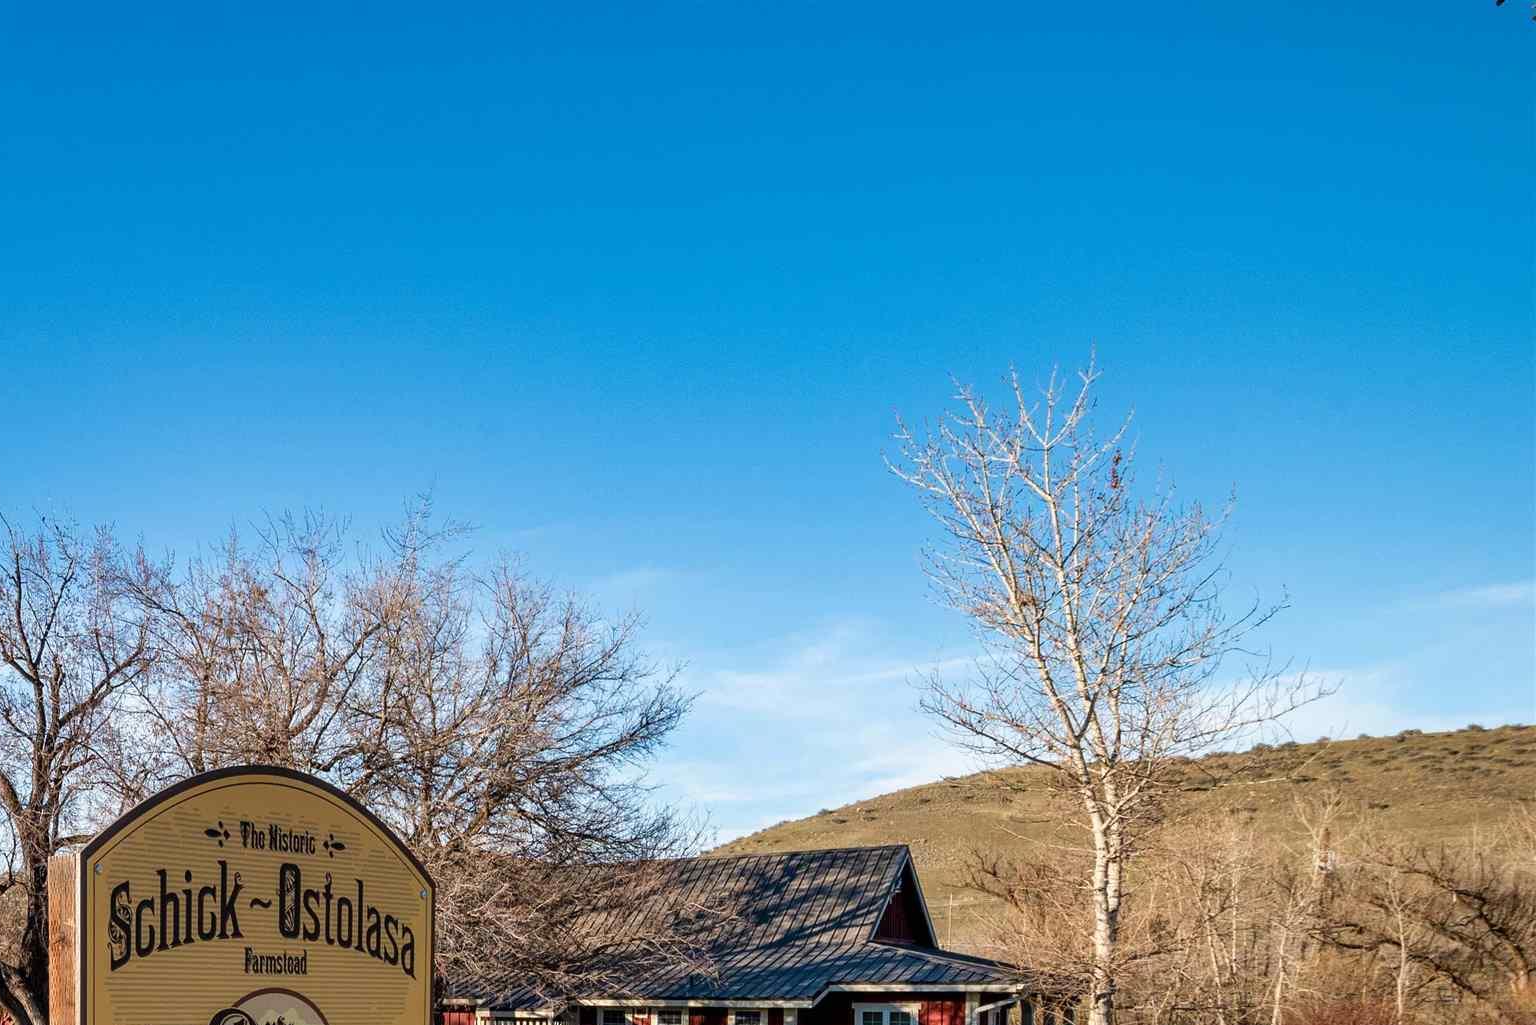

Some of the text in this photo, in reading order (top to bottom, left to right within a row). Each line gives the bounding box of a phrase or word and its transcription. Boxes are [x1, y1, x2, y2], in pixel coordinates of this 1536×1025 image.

[240, 821, 316, 854] The Historic
[108, 860, 244, 972] Schick
[278, 862, 416, 980] Ostolasa
[244, 947, 308, 975] Farmstead
